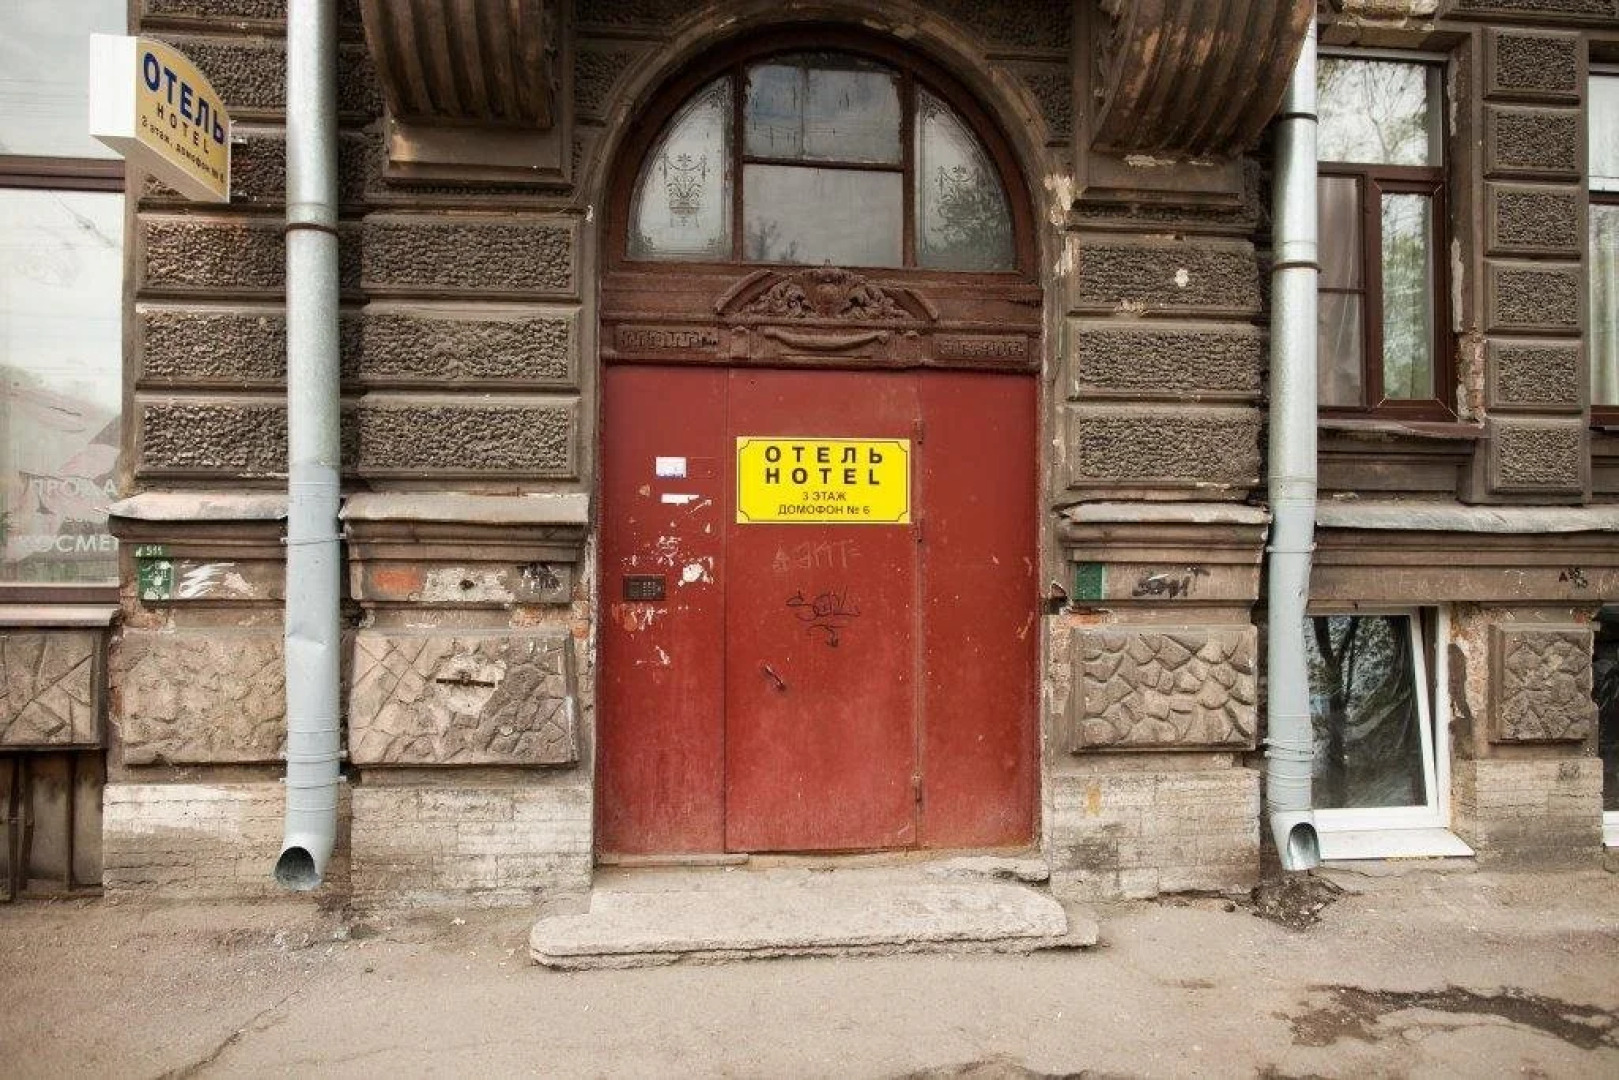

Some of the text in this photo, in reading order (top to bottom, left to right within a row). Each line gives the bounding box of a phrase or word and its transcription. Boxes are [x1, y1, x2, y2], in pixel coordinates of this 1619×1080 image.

[143, 52, 224, 145] ОТЕЛЬ
[157, 103, 209, 154] HOTEL
[764, 445, 883, 464] ОТЕЛЬ
[765, 467, 880, 485] HOTEL
[802, 491, 847, 501] 3 ЭТАЖ
[777, 504, 871, 516] ДОМОФОН № 6
